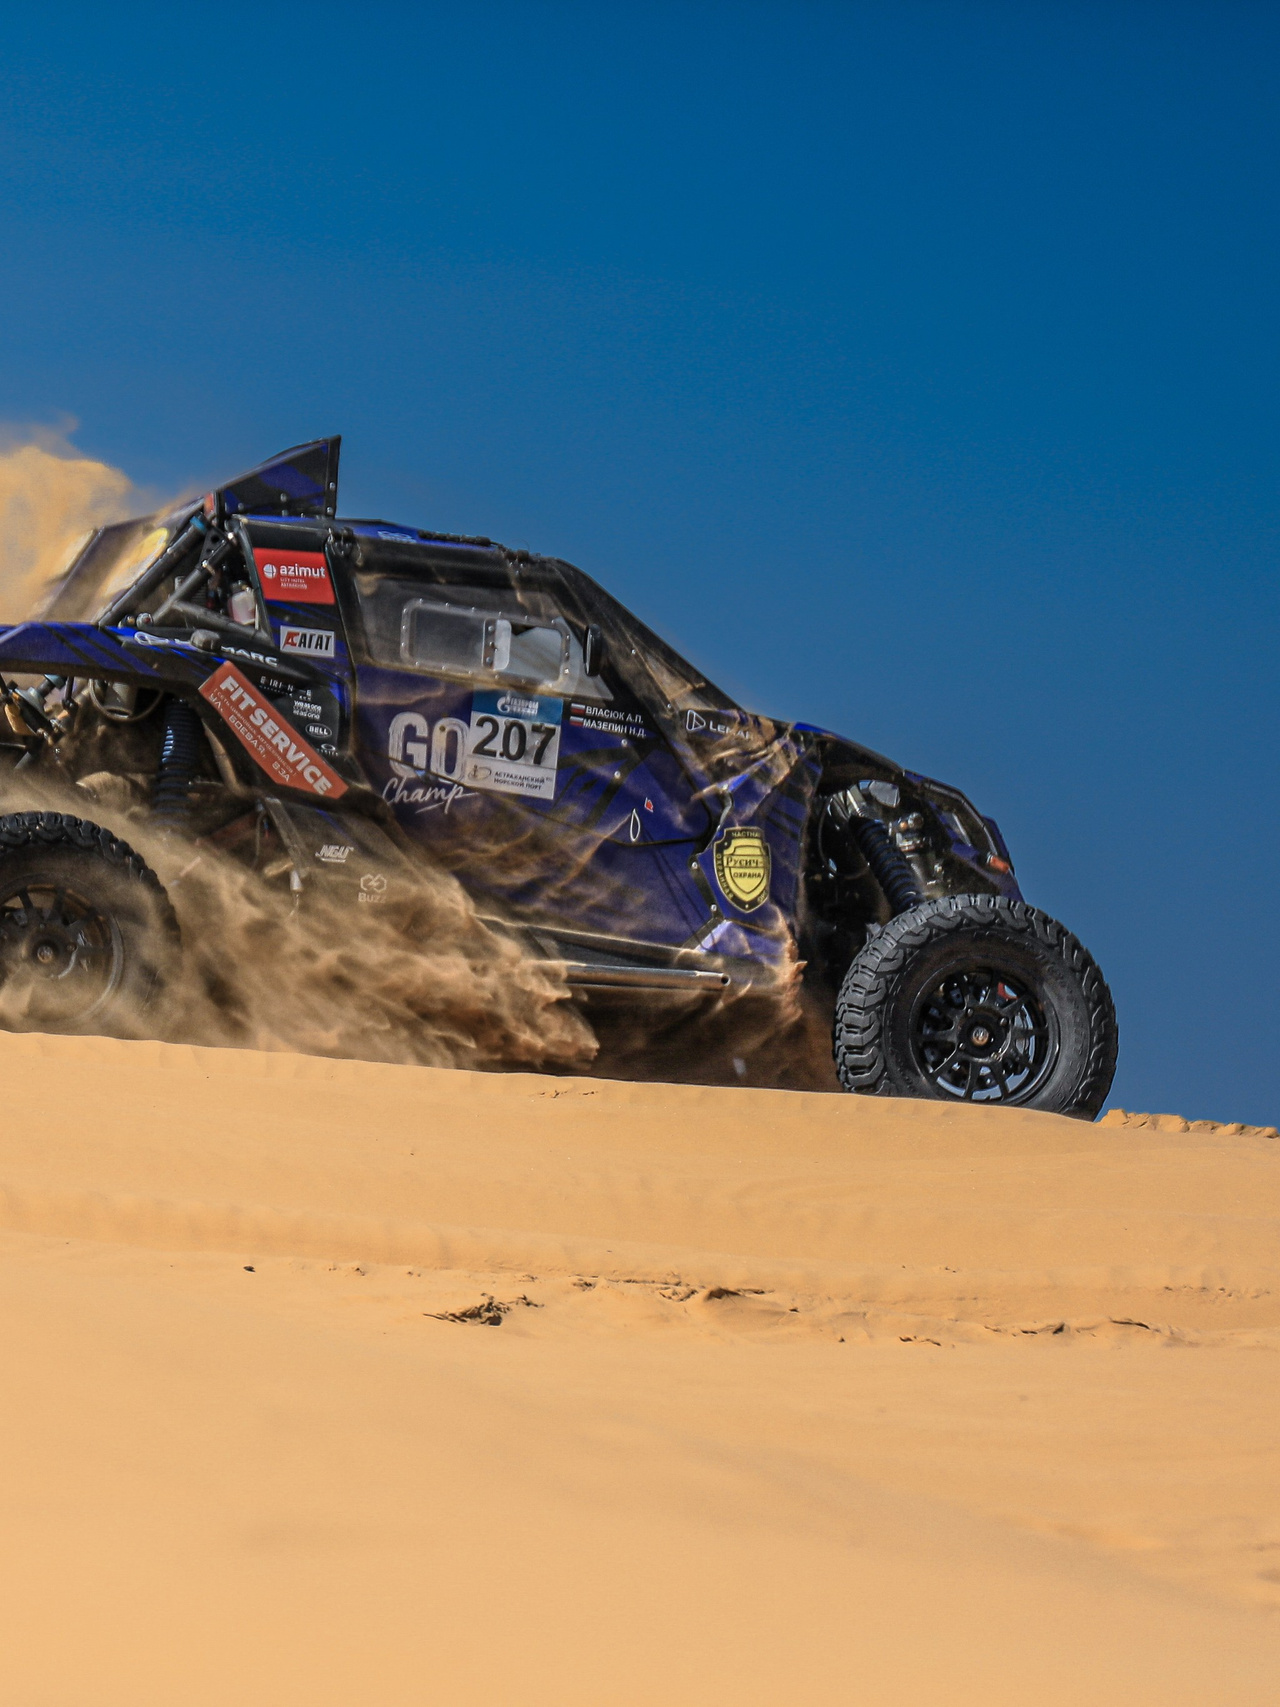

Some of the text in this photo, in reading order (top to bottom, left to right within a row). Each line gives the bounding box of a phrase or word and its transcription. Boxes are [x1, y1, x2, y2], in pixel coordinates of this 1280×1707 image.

[280, 563, 326, 578] azimut
[586, 705, 644, 724] ВЛАСЮК А.П.
[220, 675, 257, 711] FIT
[249, 708, 333, 796] SERVICE
[309, 725, 328, 735] BELL
[583, 718, 647, 738] МАЗЕПИН Н.Д.
[388, 711, 471, 785] GO
[472, 715, 556, 765] 207
[493, 777, 542, 790] МОРСКОЙ ПОРТ
[494, 770, 545, 783] АСТРАХАНСКИЙ
[382, 777, 479, 814] Champ
[733, 871, 762, 879] ОХРАНА
